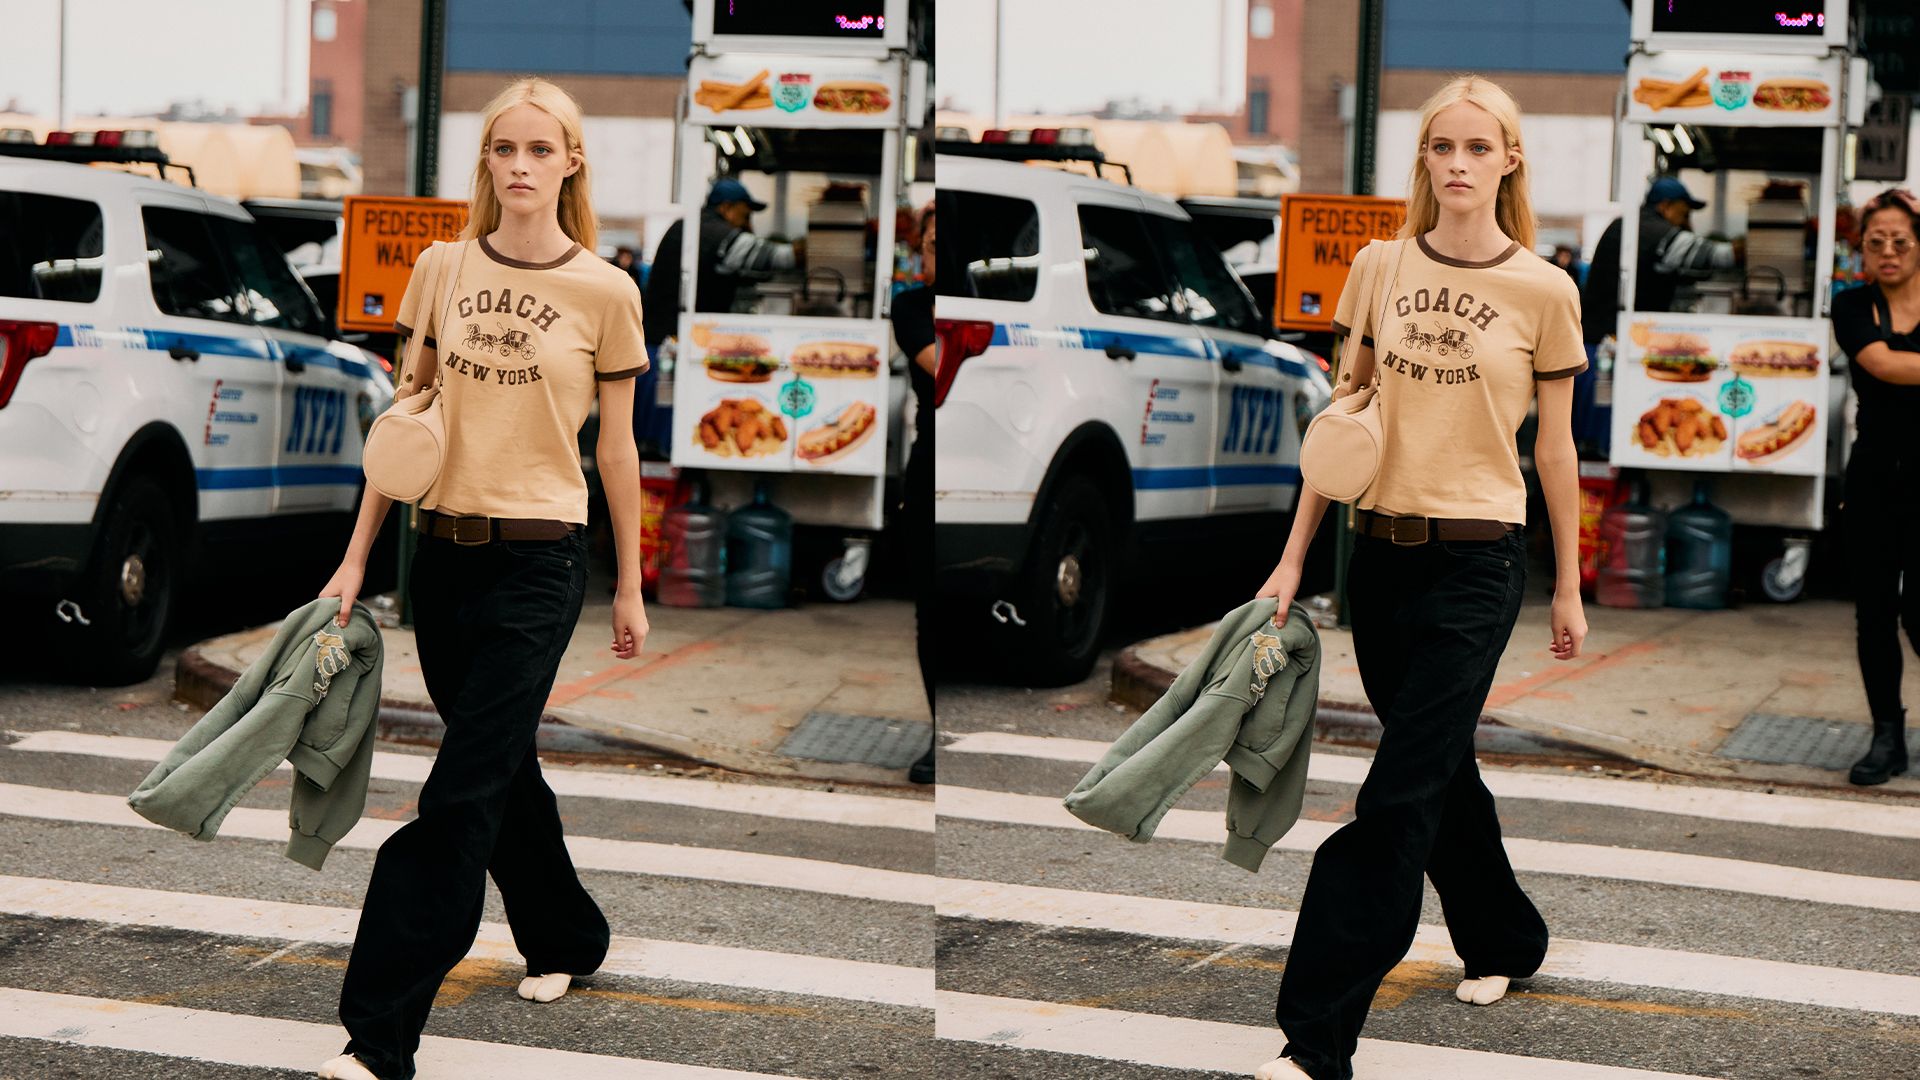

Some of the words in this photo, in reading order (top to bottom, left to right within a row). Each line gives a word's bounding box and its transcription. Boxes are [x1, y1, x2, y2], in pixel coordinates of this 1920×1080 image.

[376, 242, 427, 268] WAL
[1314, 240, 1367, 267] WAL
[457, 288, 562, 333] COACH
[1395, 287, 1500, 332] COACH
[445, 351, 491, 382] NEW
[496, 365, 543, 385] YORK
[1382, 350, 1429, 381] NEW
[1434, 364, 1481, 385] YORK
[285, 384, 347, 454] NYPD
[1222, 384, 1283, 454] NYPD
